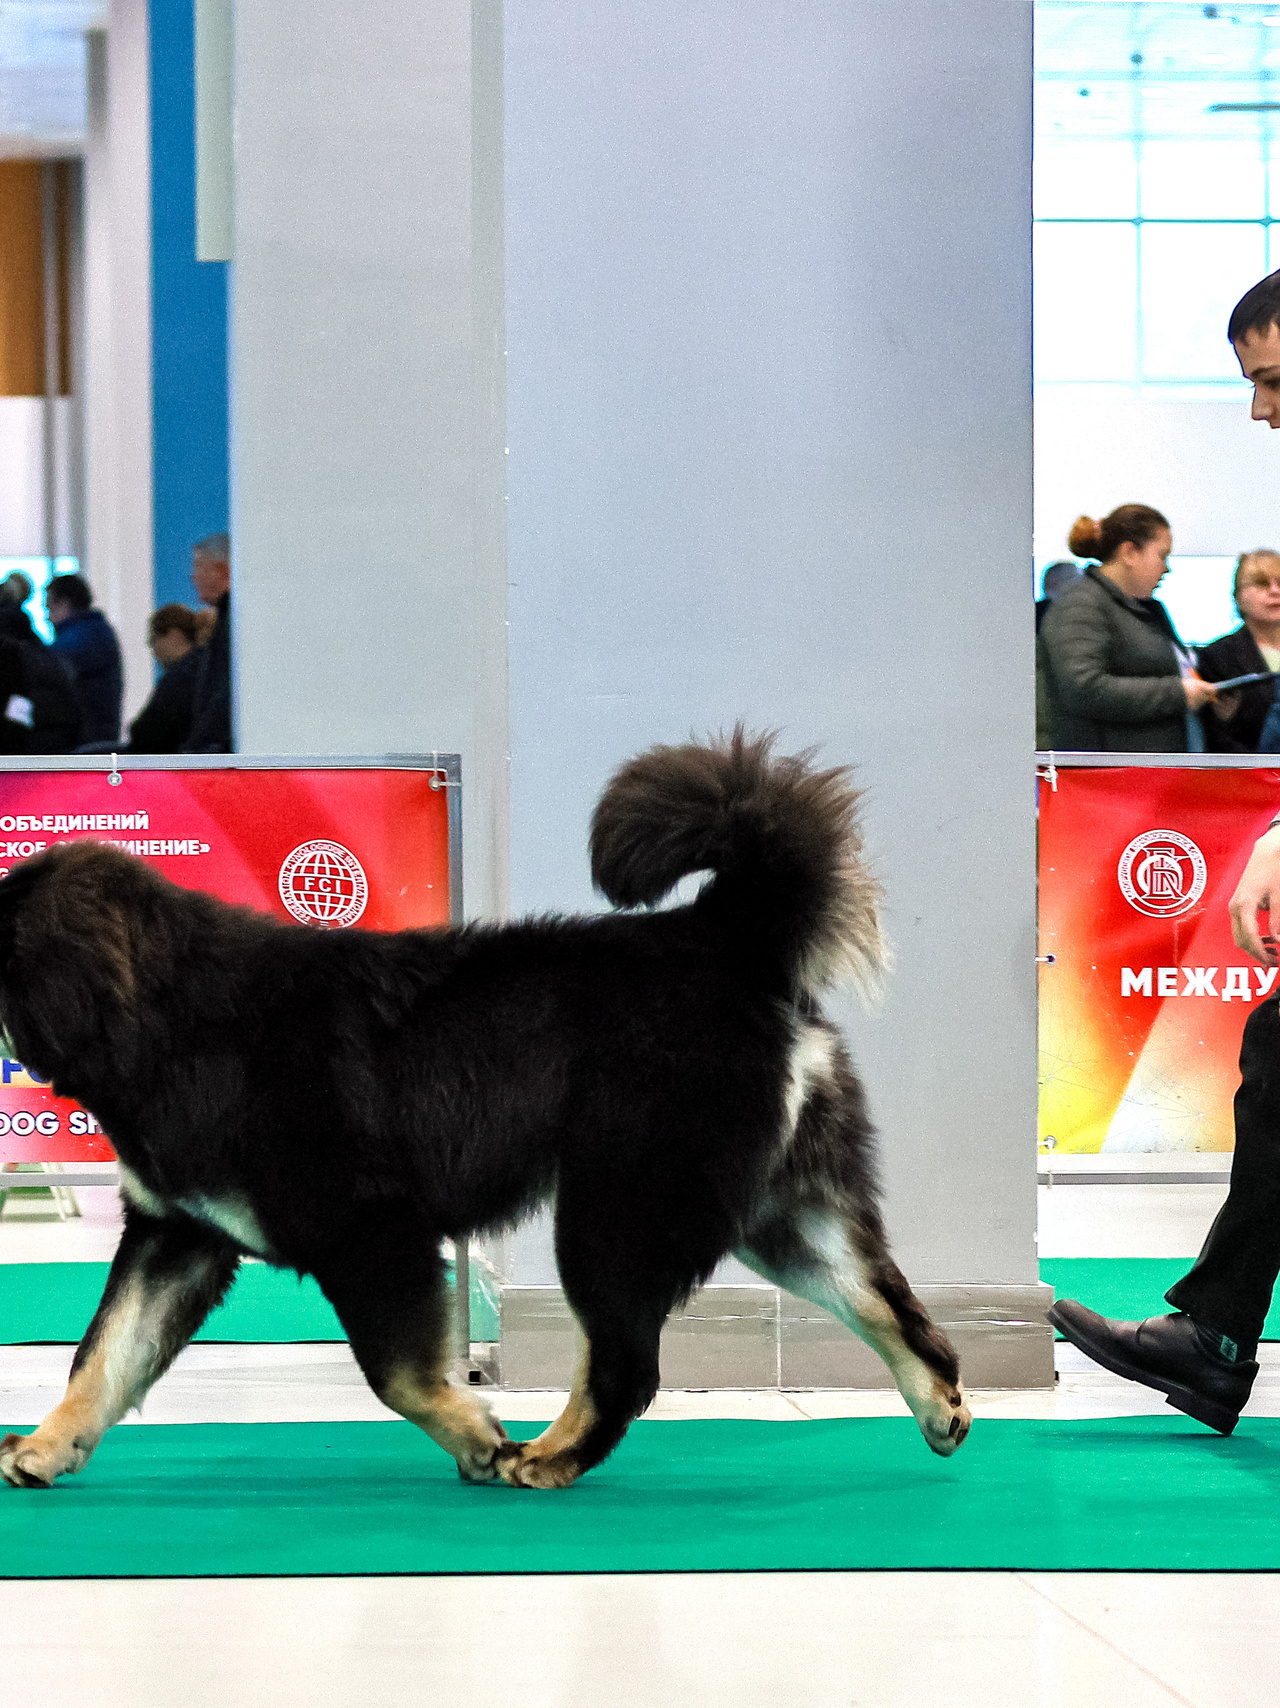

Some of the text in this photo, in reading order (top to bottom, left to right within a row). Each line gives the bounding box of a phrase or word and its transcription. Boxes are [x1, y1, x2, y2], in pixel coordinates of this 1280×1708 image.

[0, 810, 149, 833] ОБЪЕДИНЕНИЙ
[304, 877, 342, 894] FCI
[1121, 966, 1279, 1002] МЕЖДУ
